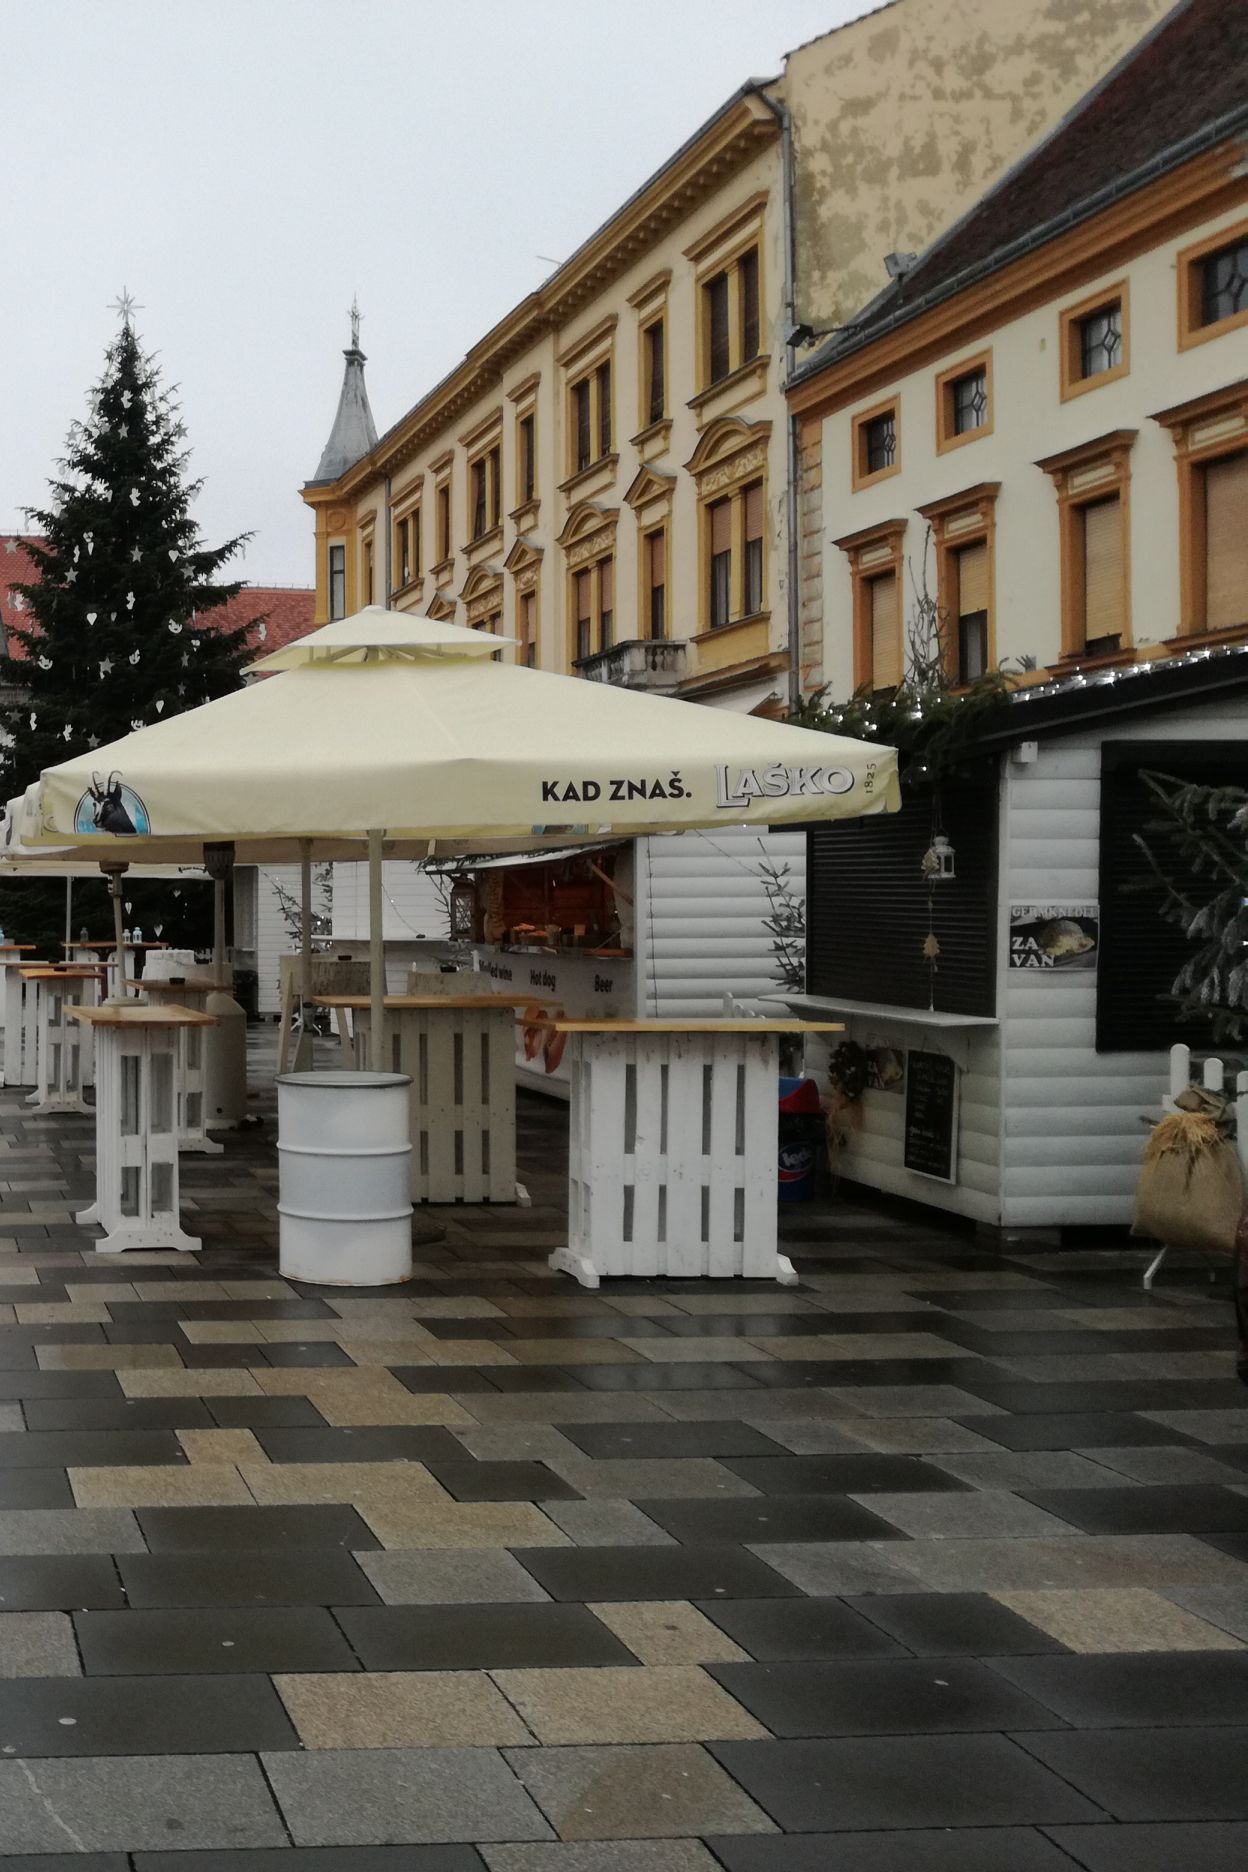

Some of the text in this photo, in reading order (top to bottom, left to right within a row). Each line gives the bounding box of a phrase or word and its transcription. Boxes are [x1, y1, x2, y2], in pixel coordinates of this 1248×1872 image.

[542, 770, 692, 802] KAD ZNAŠ.
[864, 762, 877, 794] 1825
[1012, 936, 1039, 950] ZA
[1012, 953, 1055, 968] VAN
[530, 968, 556, 993] Hot dog
[594, 973, 614, 993] Beer
